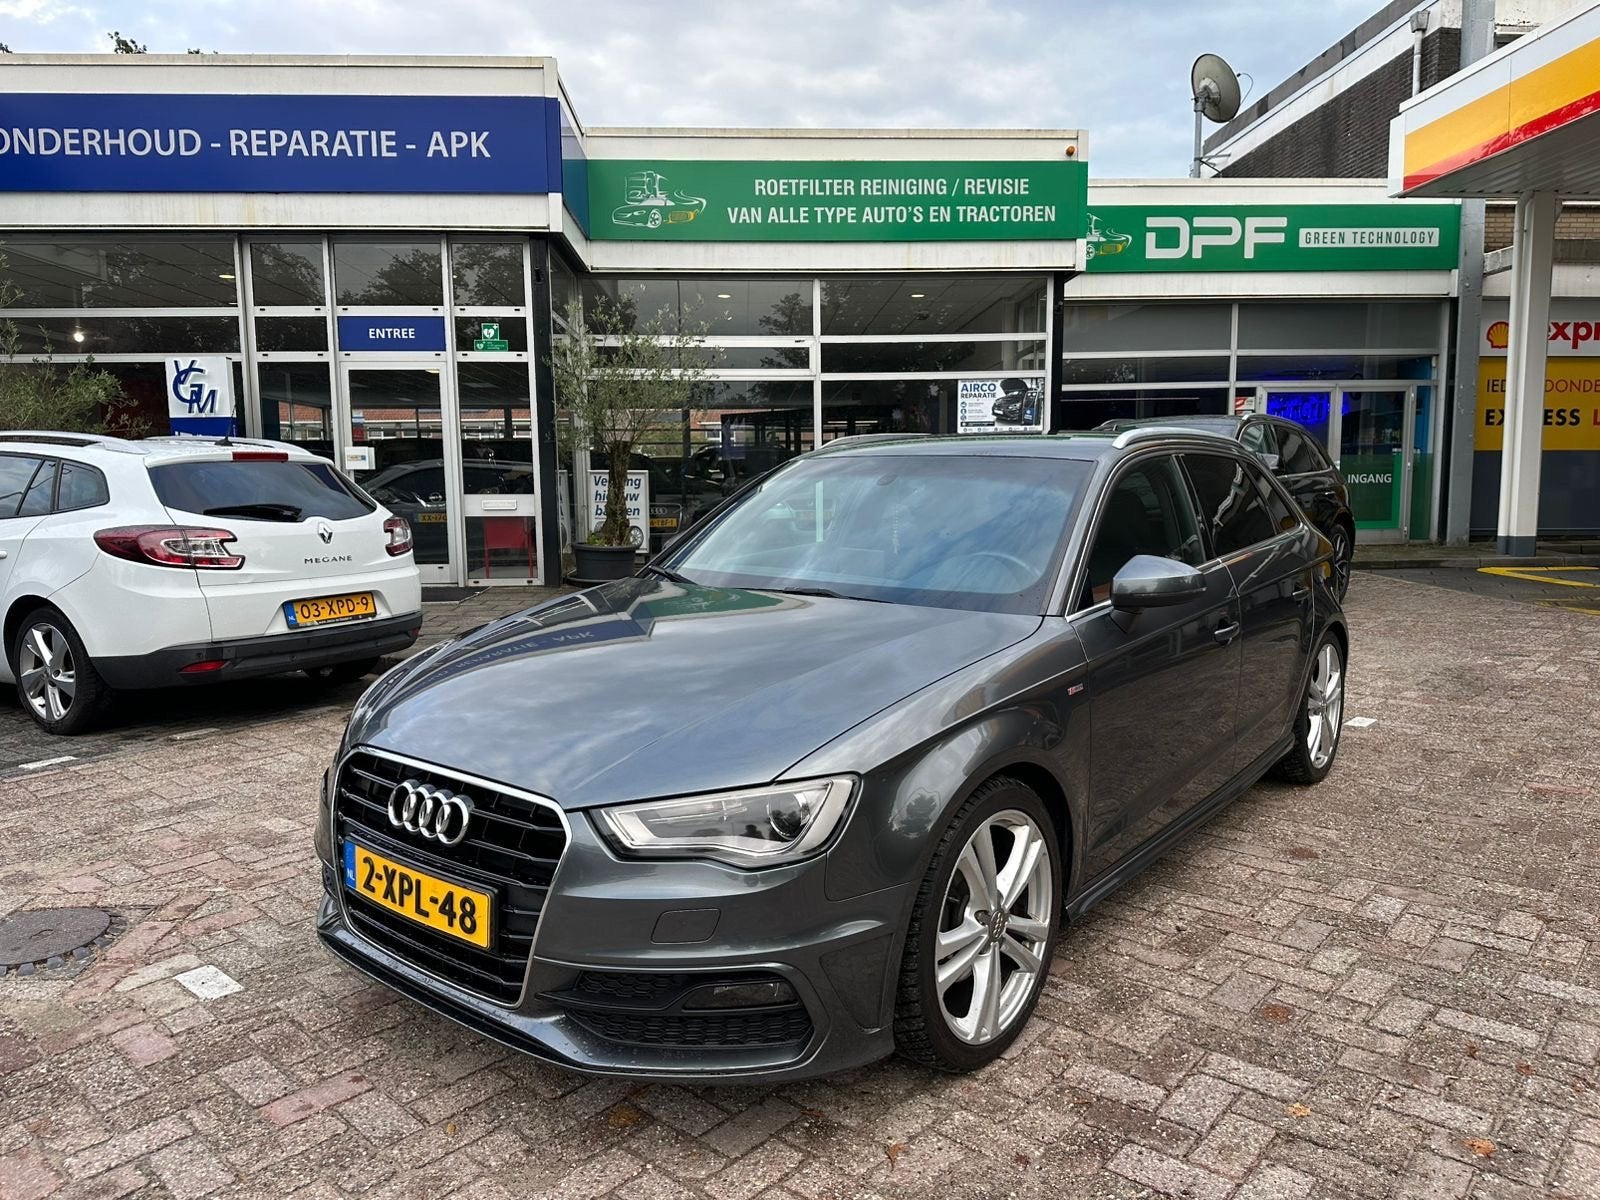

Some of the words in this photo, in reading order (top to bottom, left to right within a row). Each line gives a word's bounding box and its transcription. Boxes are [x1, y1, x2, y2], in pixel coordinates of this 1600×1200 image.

[229, 129, 398, 158] REPARATIE
[426, 131, 491, 158] APK
[754, 178, 855, 196] ROETFILTER
[860, 178, 947, 196] REINIGING
[951, 177, 960, 197] /
[964, 178, 1030, 195] REVISIE
[727, 206, 762, 224] VAN
[767, 206, 809, 224] ALLE
[814, 206, 857, 224] TYPE
[862, 206, 924, 223] AUTO’S
[929, 206, 951, 222] EN
[956, 205, 1056, 222] TRACTOREN
[1145, 216, 1288, 259] DPF
[1304, 231, 1346, 244] GREEN
[1352, 230, 1435, 244] TECHNOLOGY
[368, 327, 416, 339] ENTREE
[960, 383, 998, 393] AIRCO
[1347, 473, 1393, 484] INGANG
[304, 555, 353, 564] MEGANE
[300, 596, 369, 620] 03-XPD-9
[346, 867, 356, 881] NL
[363, 856, 477, 935] 2-XPL-48
